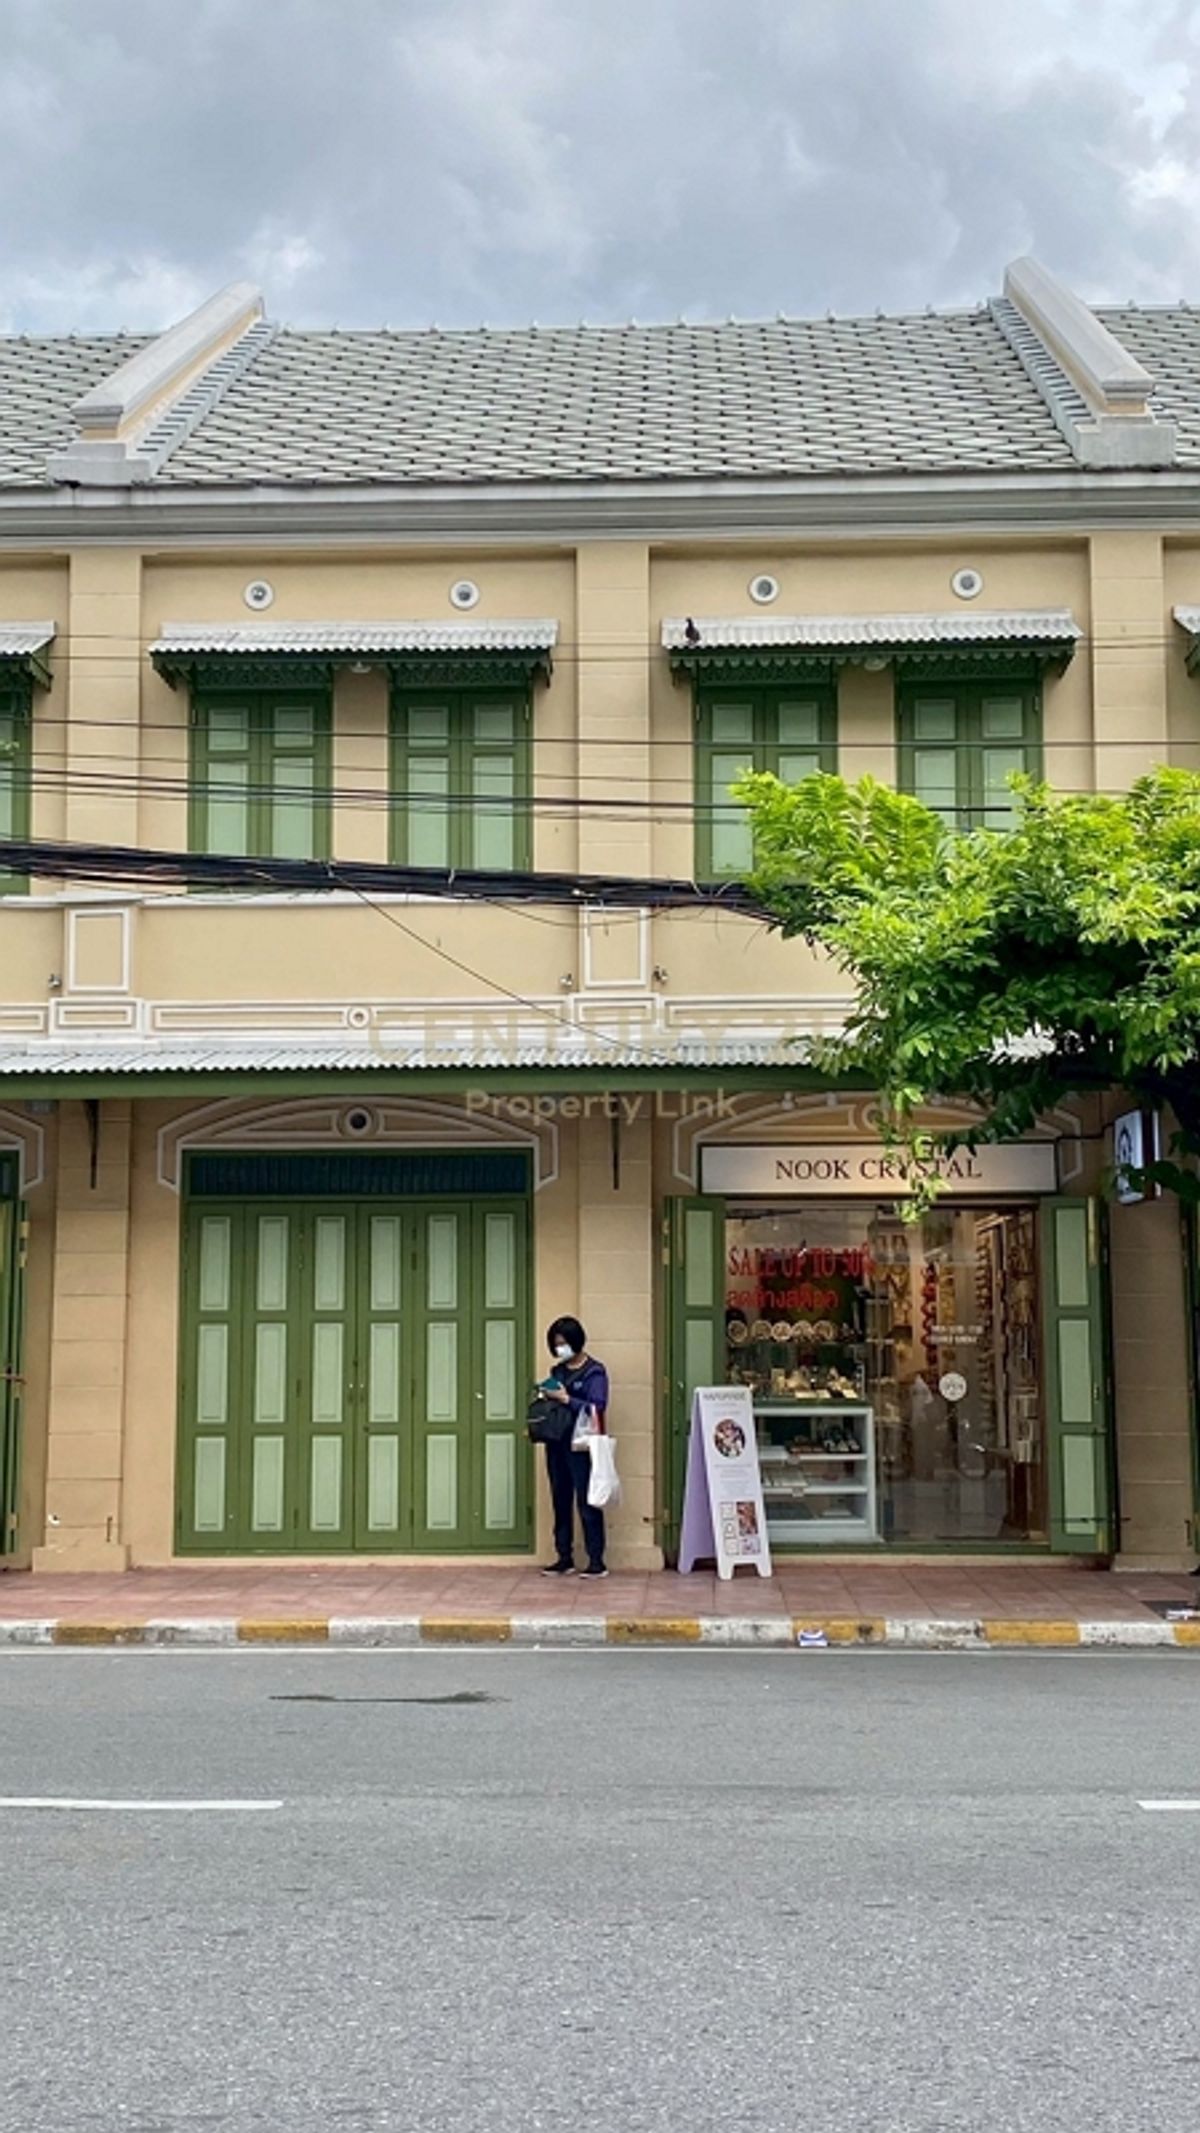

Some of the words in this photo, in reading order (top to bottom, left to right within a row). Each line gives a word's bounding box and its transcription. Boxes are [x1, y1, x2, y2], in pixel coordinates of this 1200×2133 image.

[775, 1159, 850, 1180] NOOK
[859, 1158, 983, 1180] CRYSTAL
[728, 1247, 777, 1277] SALE
[781, 1247, 808, 1278] UP
[812, 1248, 837, 1278] TO
